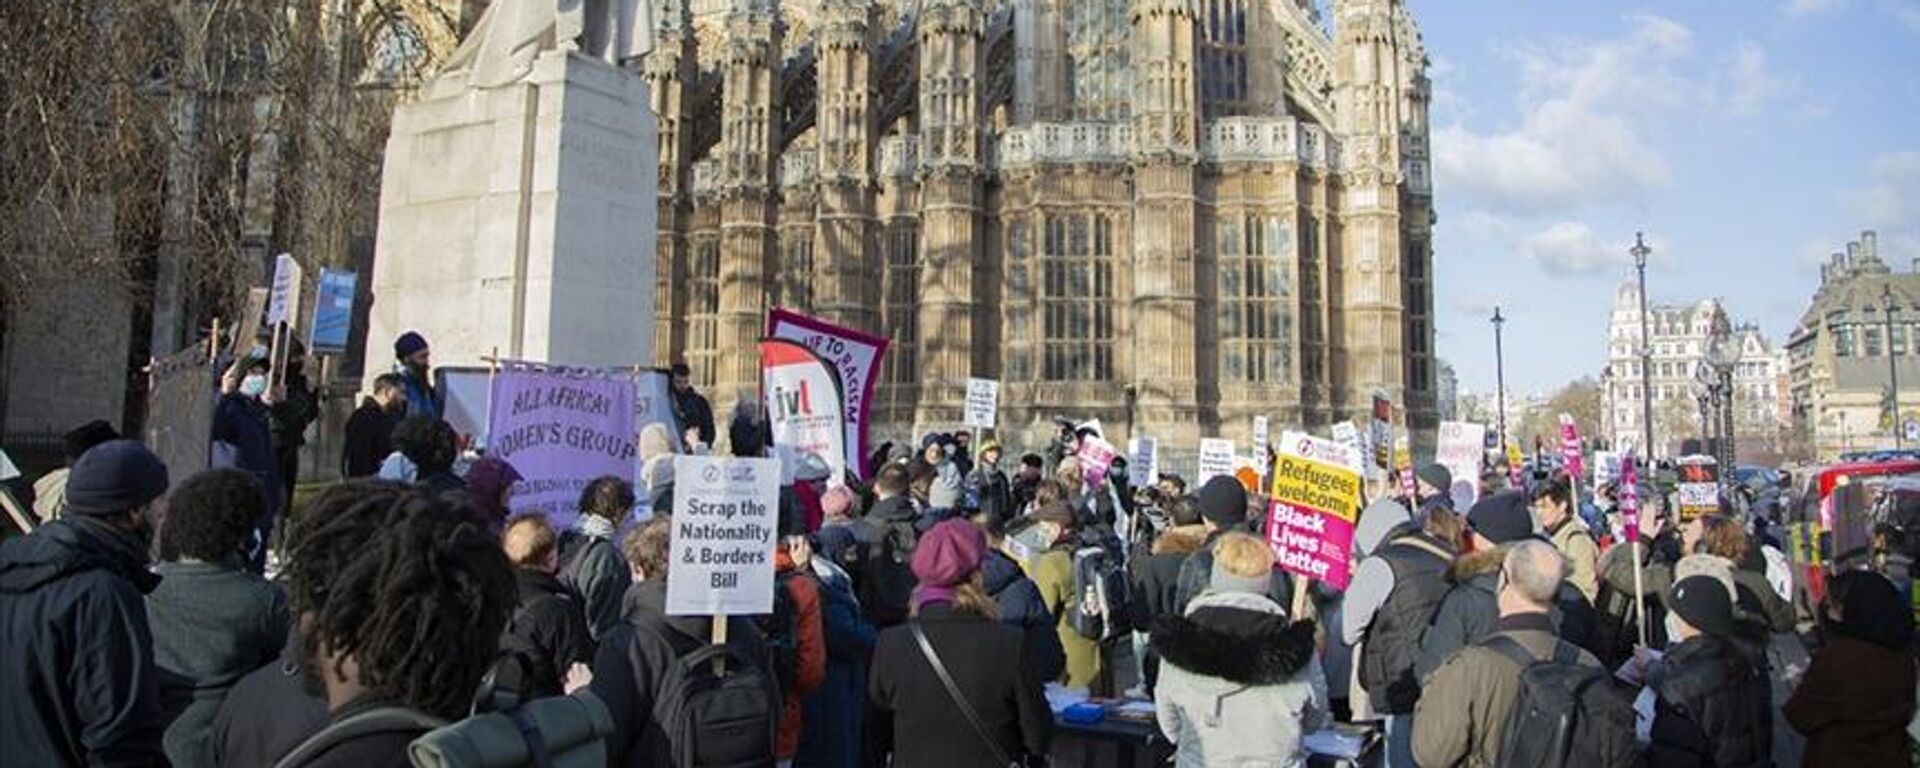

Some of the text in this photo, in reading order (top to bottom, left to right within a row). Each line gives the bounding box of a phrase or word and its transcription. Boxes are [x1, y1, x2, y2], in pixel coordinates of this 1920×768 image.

[826, 337, 844, 354] TO
[512, 387, 546, 416] ALL
[775, 380, 812, 422] jvl
[566, 426, 636, 460] GROUP
[1280, 459, 1355, 497] Refugees
[687, 498, 766, 519] Scrap the
[1277, 482, 1350, 515] welcome
[1273, 502, 1327, 534] Black
[679, 523, 770, 543] Nationality
[1271, 522, 1319, 552] Lives
[682, 546, 765, 564] & Borders
[711, 572, 738, 589] Bill
